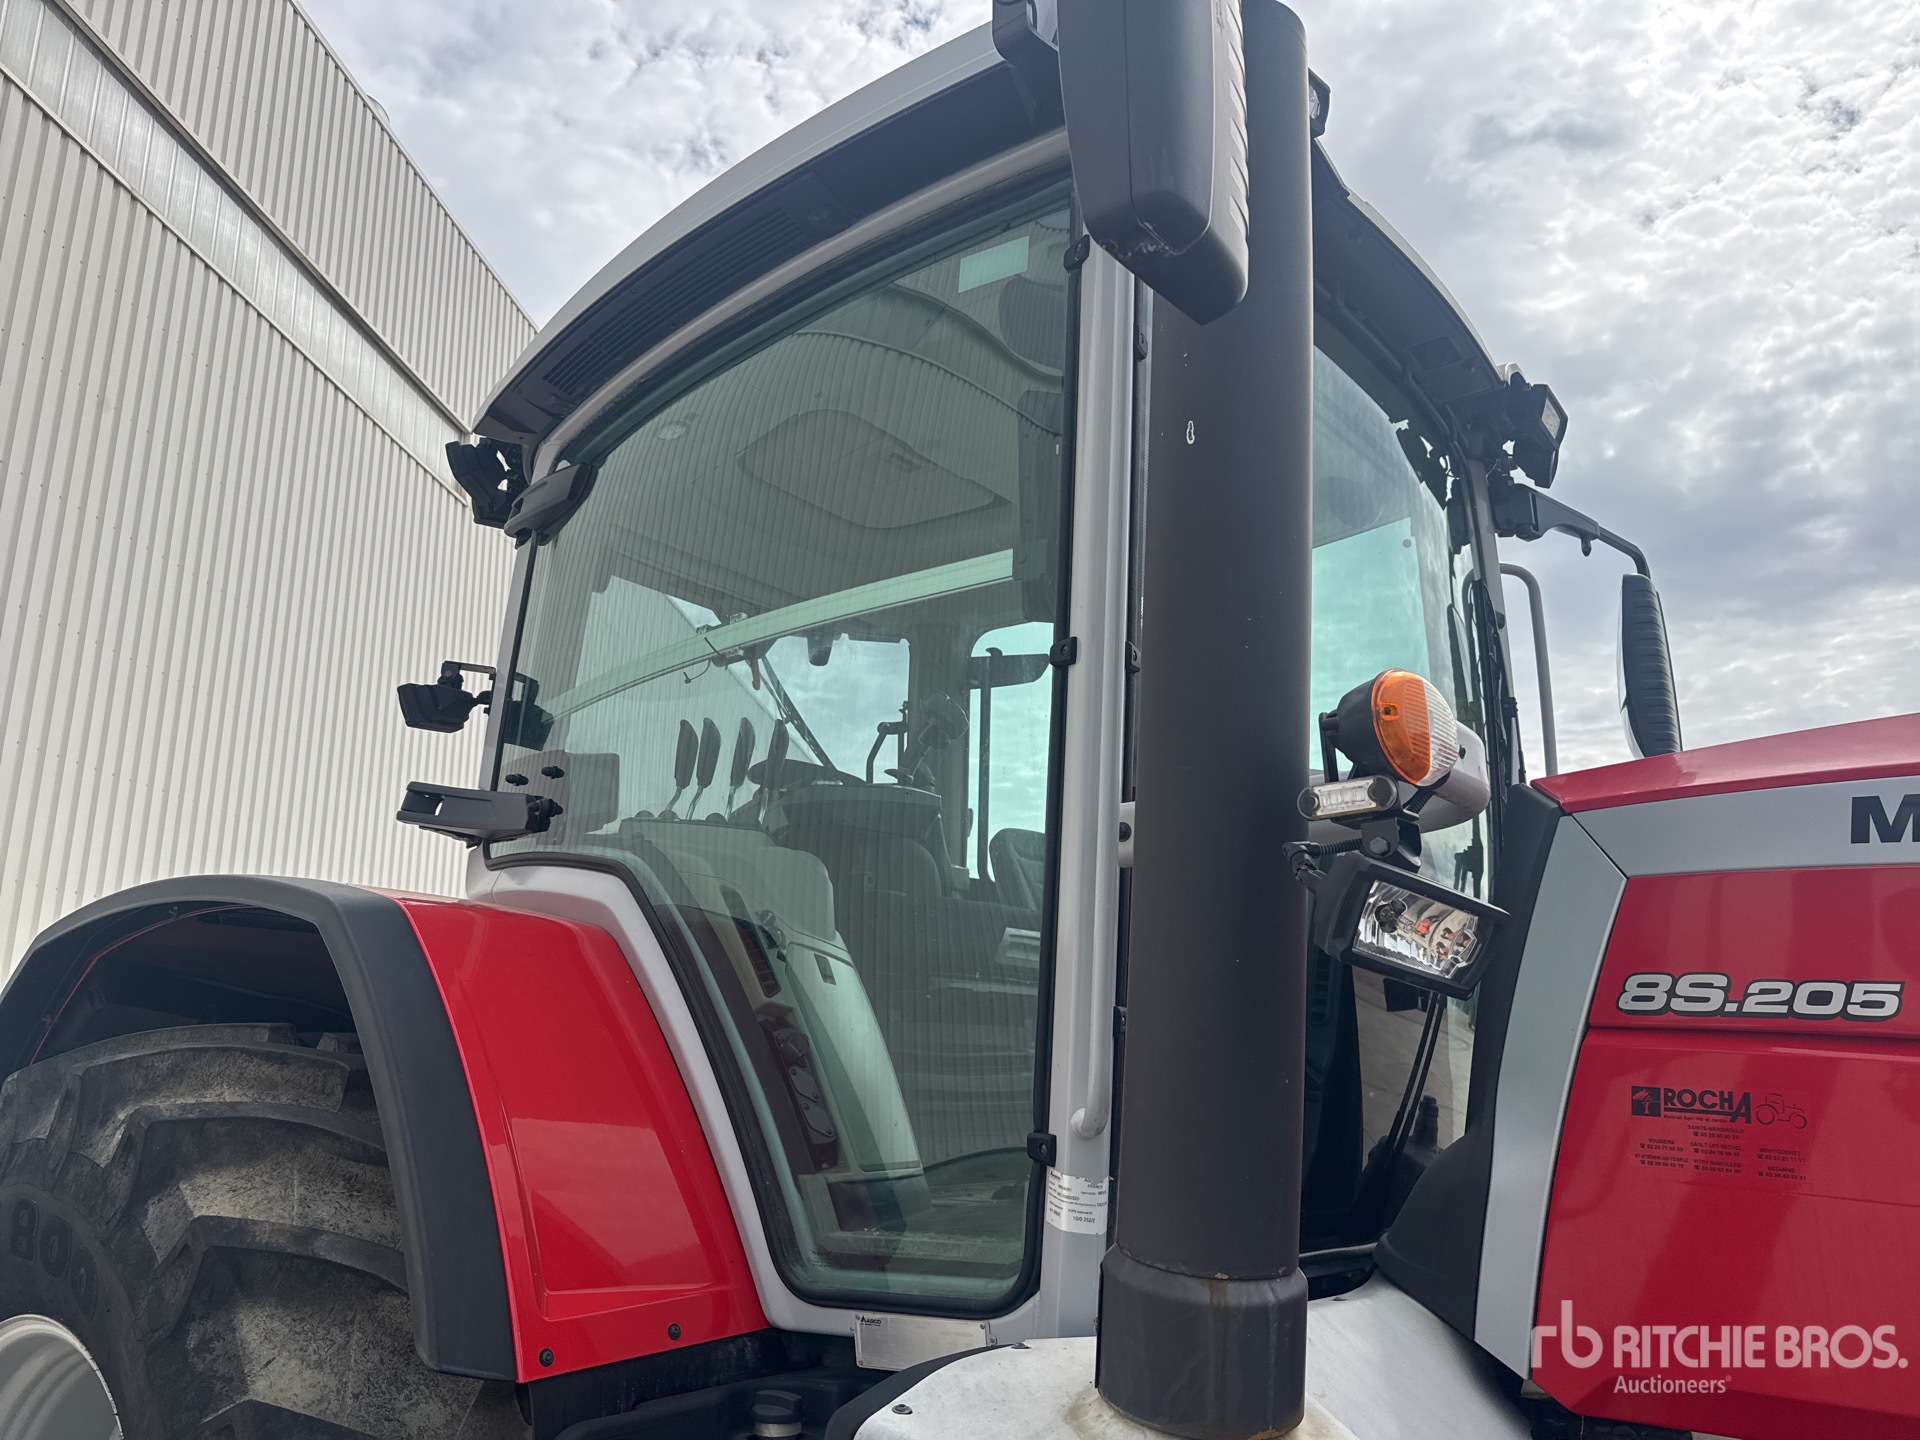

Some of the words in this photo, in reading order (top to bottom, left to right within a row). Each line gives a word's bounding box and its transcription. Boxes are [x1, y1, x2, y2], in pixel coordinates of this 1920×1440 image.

[1851, 794, 1920, 844] M
[1616, 972, 1905, 1022] 8S.205
[1663, 1088, 1751, 1124] ROCHA
